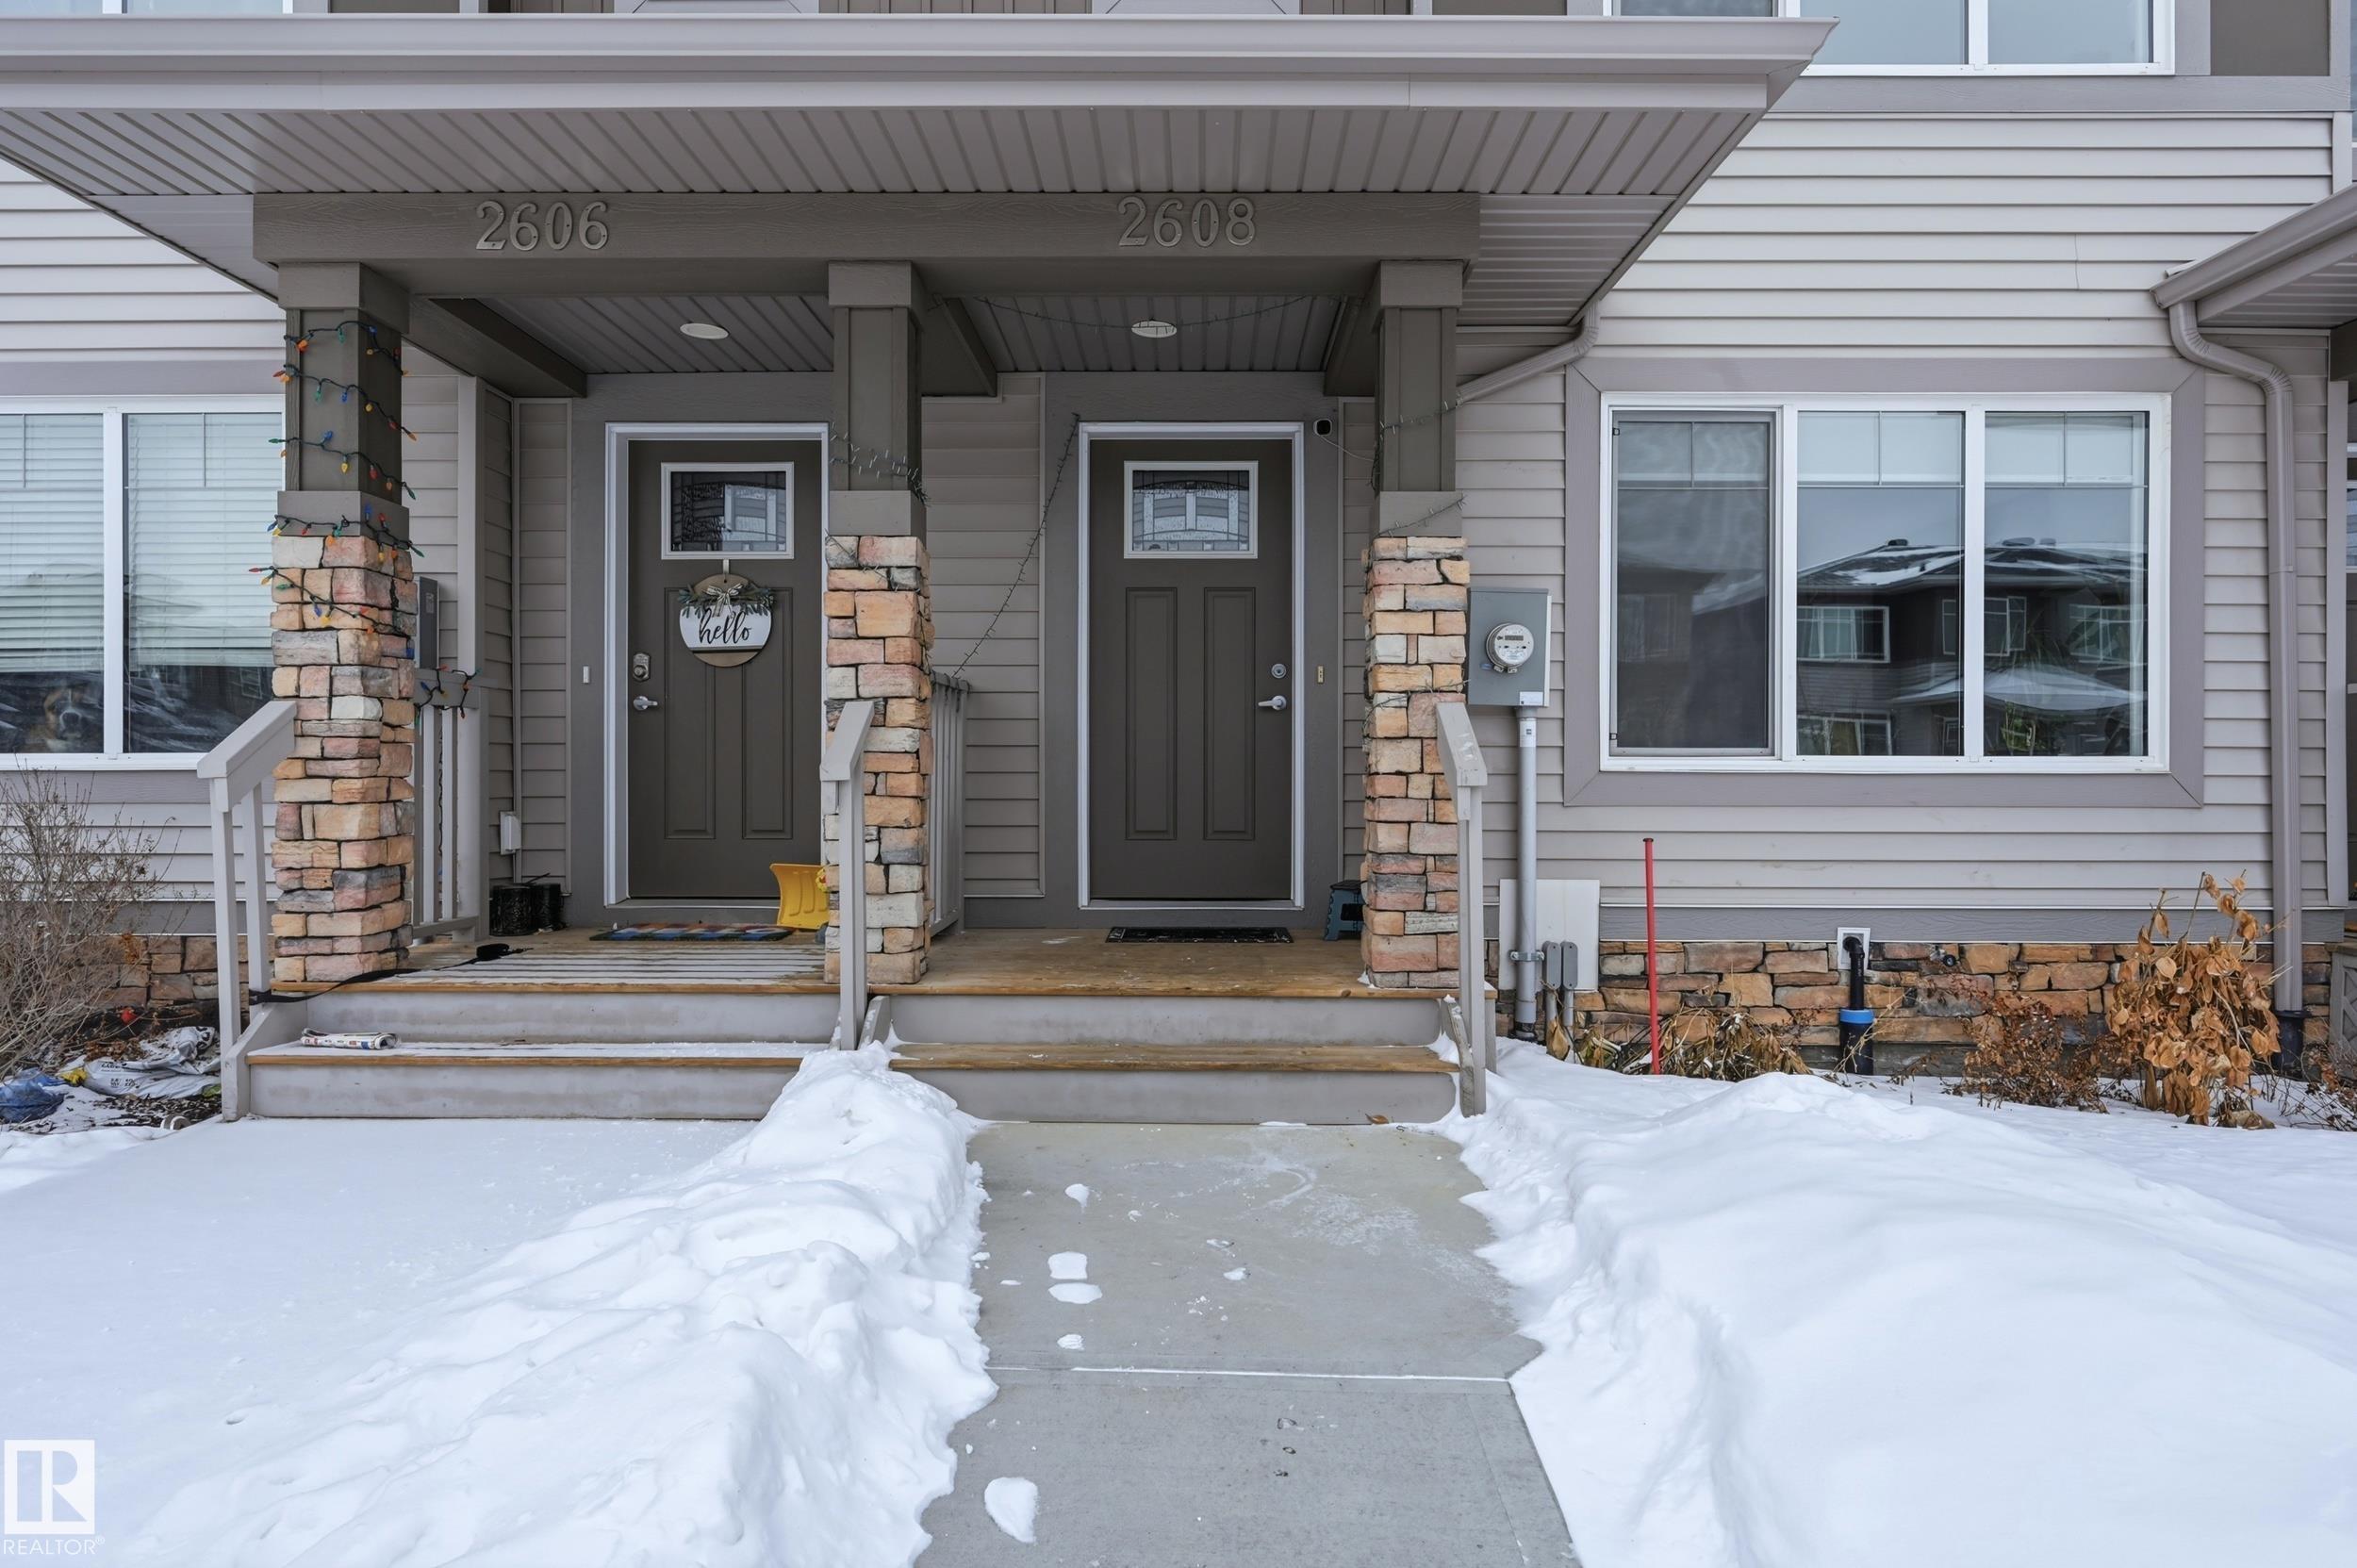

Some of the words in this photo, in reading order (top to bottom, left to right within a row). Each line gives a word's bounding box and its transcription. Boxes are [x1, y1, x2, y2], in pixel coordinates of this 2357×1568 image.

[475, 200, 609, 251] 2606
[1117, 196, 1255, 247] 2608
[699, 607, 752, 645] hello
